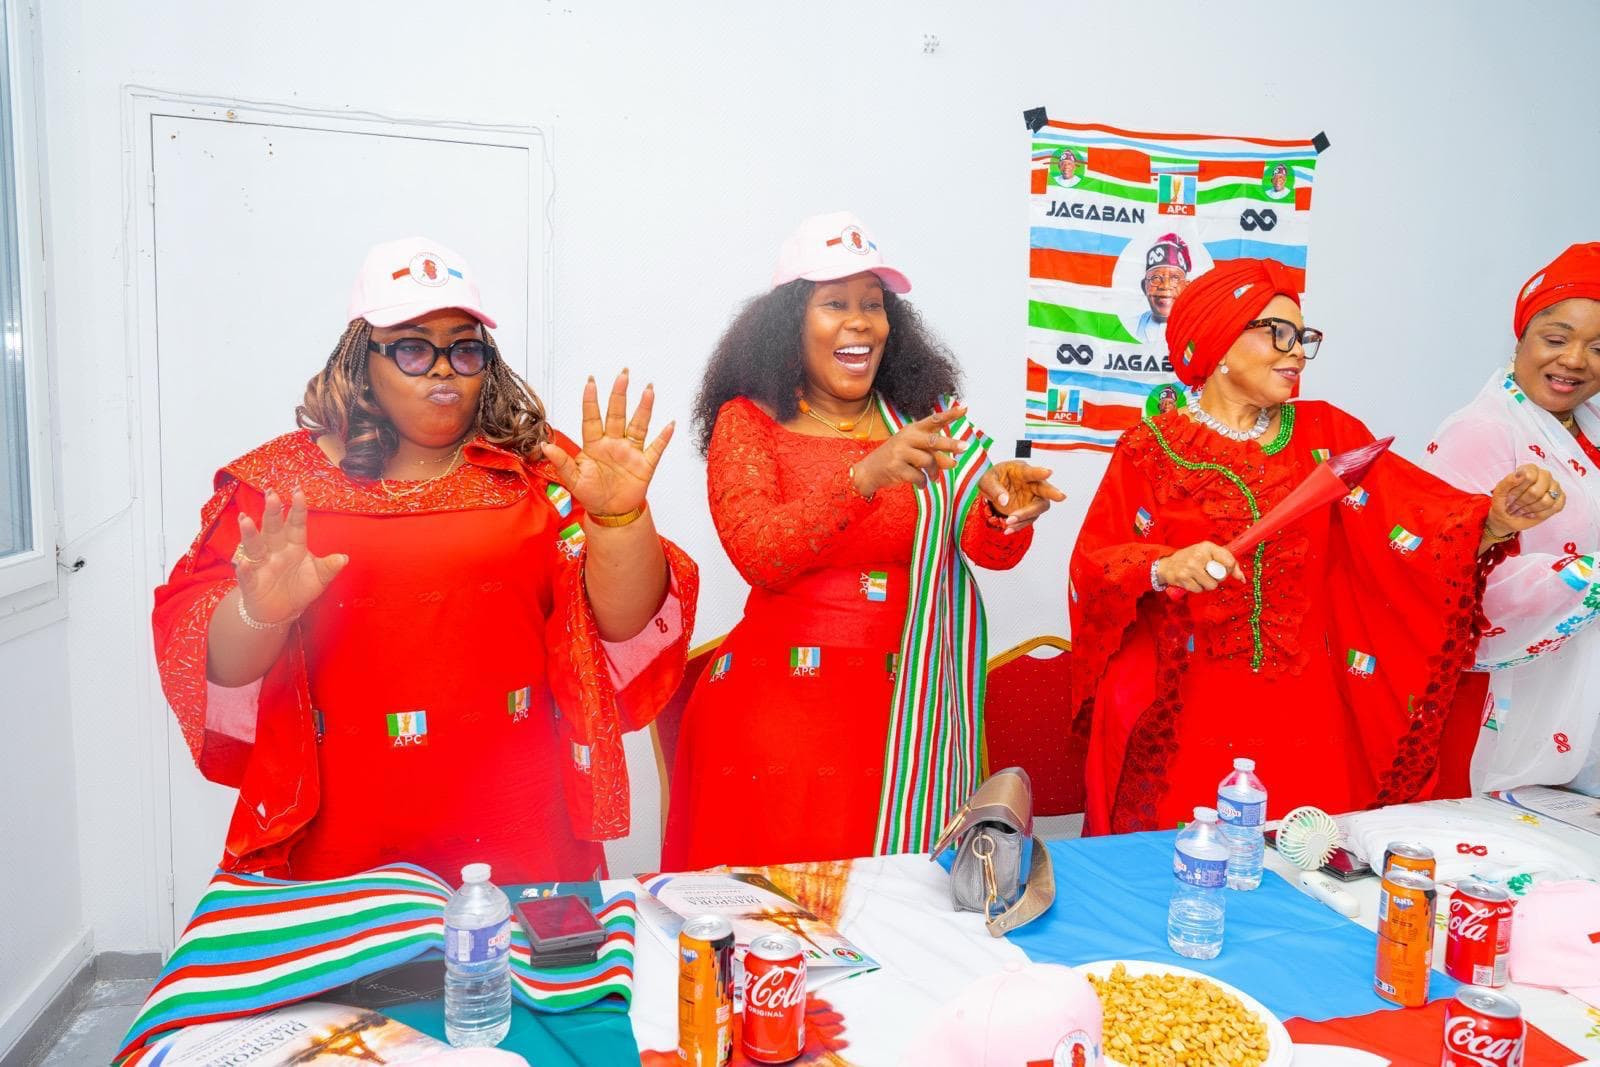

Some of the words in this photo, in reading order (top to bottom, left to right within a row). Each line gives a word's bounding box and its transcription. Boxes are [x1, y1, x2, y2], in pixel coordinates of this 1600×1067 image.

[1046, 200, 1145, 224] JAGABAN
[1166, 204, 1188, 214] APC
[1103, 353, 1175, 372] JAGAB
[1053, 412, 1072, 421] APC
[1341, 495, 1360, 511] APC
[556, 540, 575, 561] APC
[1389, 541, 1409, 555] APC
[860, 572, 870, 595] APC
[709, 672, 726, 683] APC
[793, 665, 816, 676] APC
[1347, 666, 1369, 680] APC
[512, 708, 529, 724] APC
[393, 734, 423, 747] APC
[747, 1004, 785, 1018] ORIGINAL
